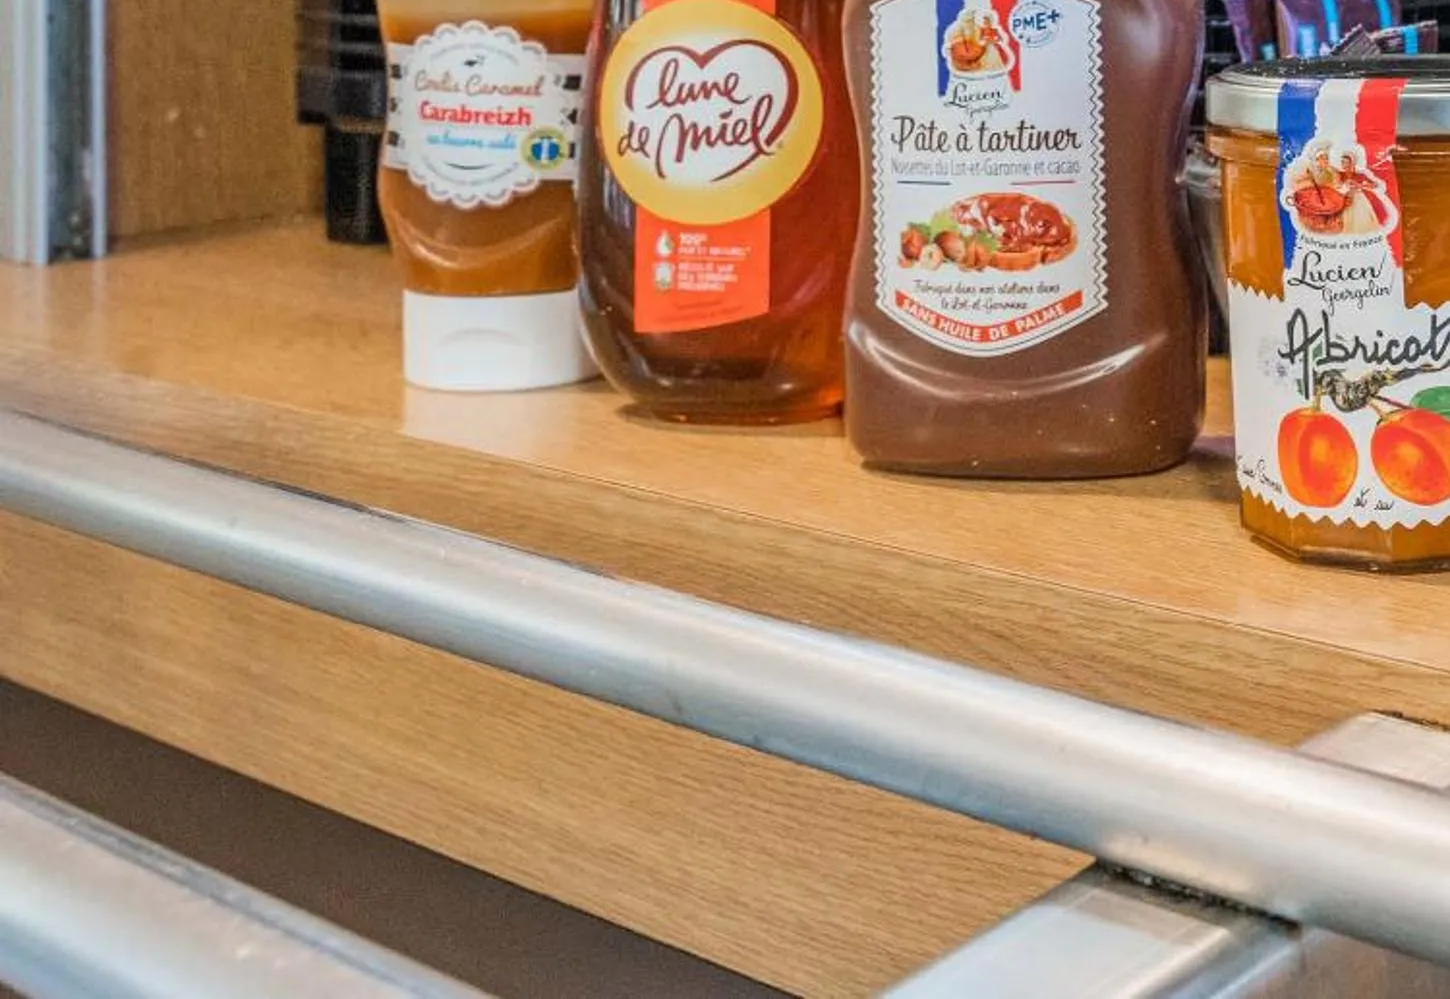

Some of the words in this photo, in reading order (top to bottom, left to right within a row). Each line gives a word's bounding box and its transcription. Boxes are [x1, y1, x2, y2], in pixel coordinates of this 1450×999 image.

[1011, 8, 1060, 32] PME+
[465, 74, 545, 97] Caramel
[420, 100, 533, 126] Carabreizh
[617, 120, 651, 159] de
[891, 114, 950, 154] Pâte
[955, 124, 972, 152] à
[979, 119, 1082, 154] tartiner
[1287, 250, 1387, 290] Lucien
[1322, 279, 1394, 317] Georgelin
[937, 317, 982, 341] HUILE
[989, 324, 1009, 341] DE
[1015, 304, 1064, 333] PALME
